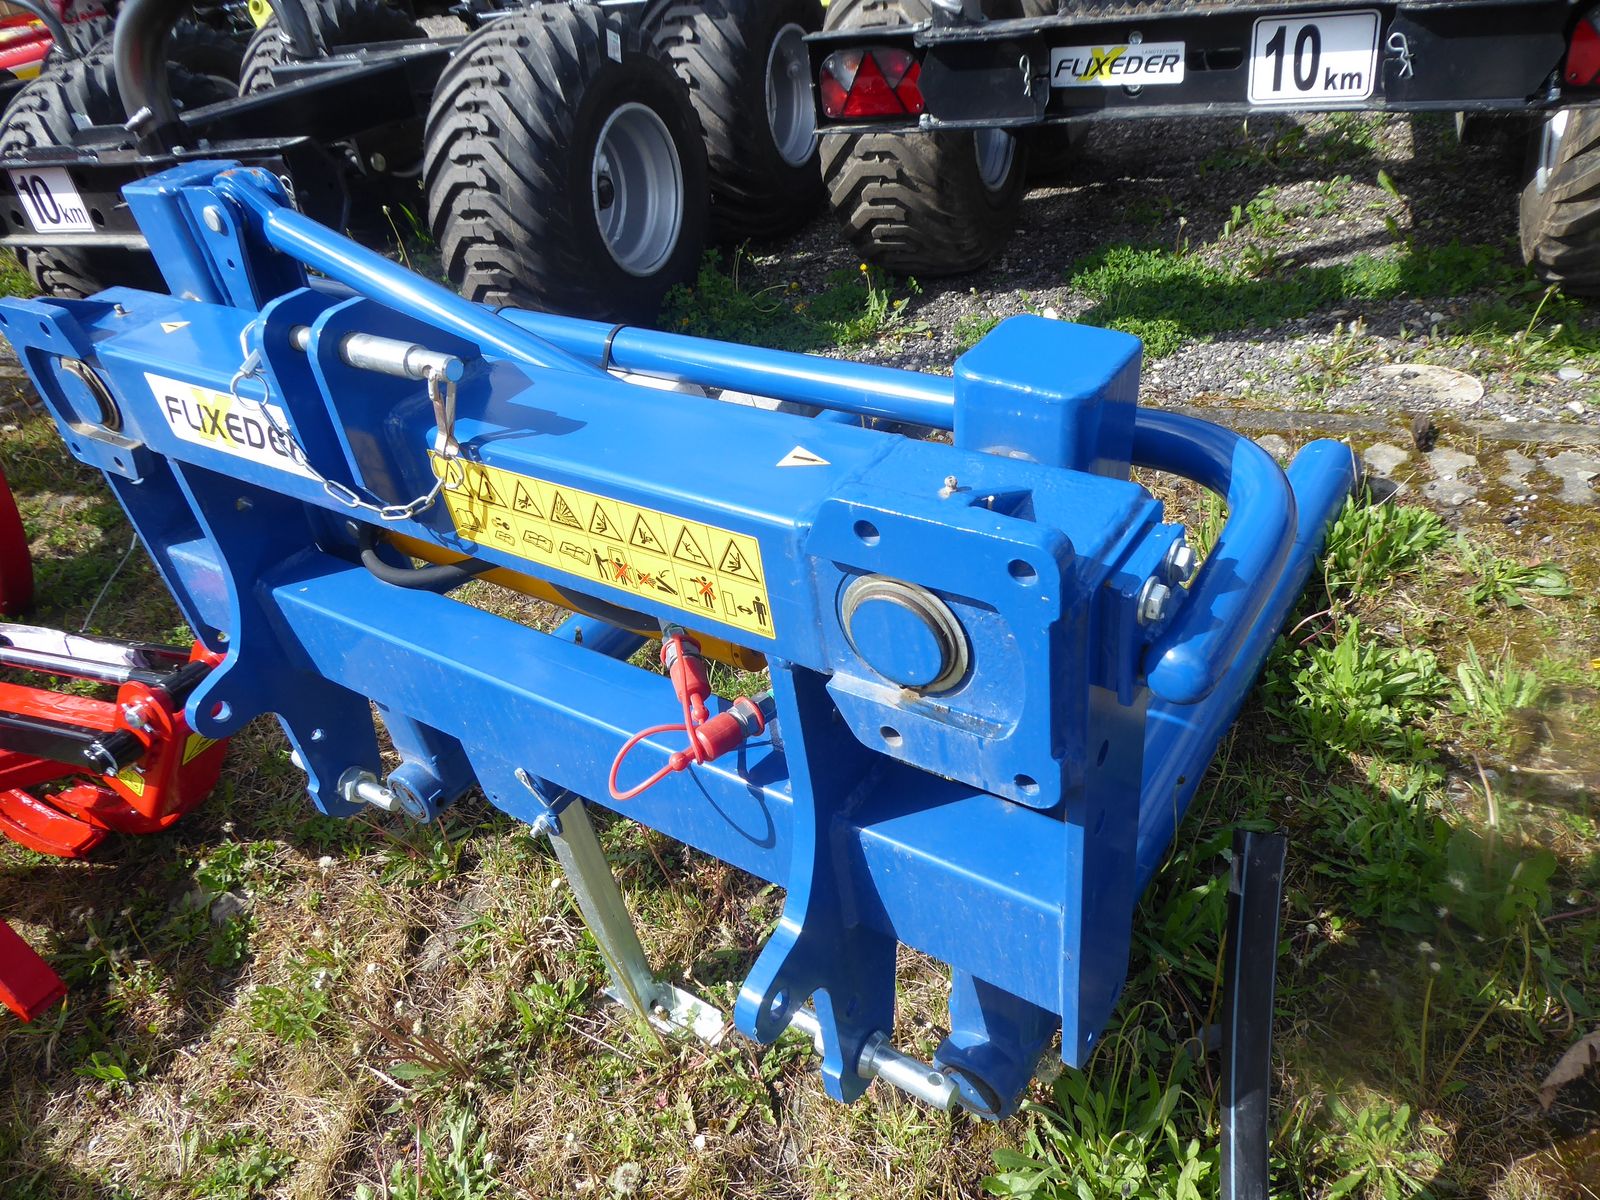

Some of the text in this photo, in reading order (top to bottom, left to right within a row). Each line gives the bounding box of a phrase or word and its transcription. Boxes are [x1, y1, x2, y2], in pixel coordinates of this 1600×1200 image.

[1053, 52, 1181, 80] FLIXEDER
[1265, 24, 1362, 92] 10 km
[17, 174, 87, 224] 10 km
